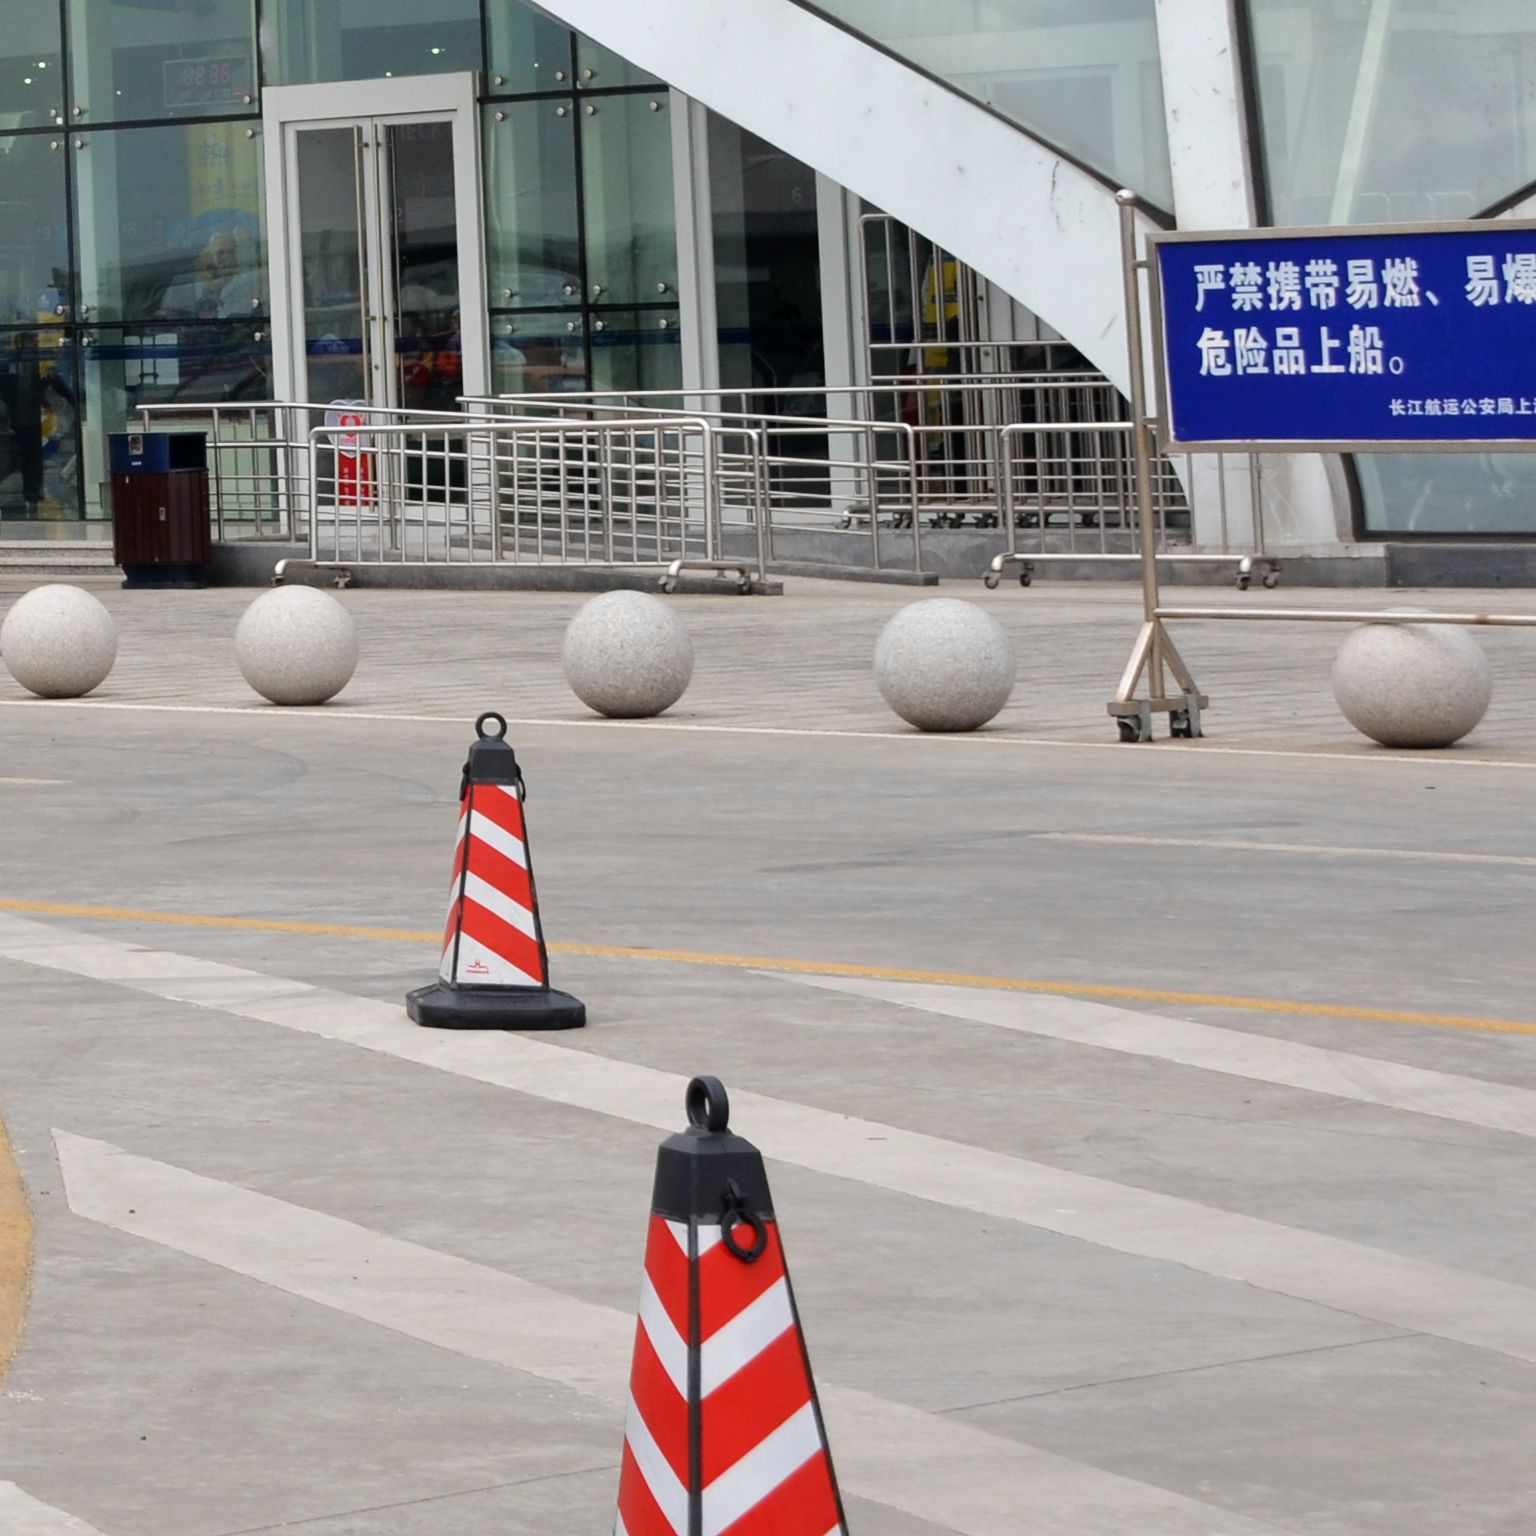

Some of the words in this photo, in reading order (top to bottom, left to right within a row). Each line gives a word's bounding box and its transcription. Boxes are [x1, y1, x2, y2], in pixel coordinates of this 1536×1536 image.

[1194, 253, 1536, 312] 严禁携带易燃、易爆
[1196, 324, 1404, 376] 危险品上船。
[1388, 397, 1536, 416] 长江航运公安局上
